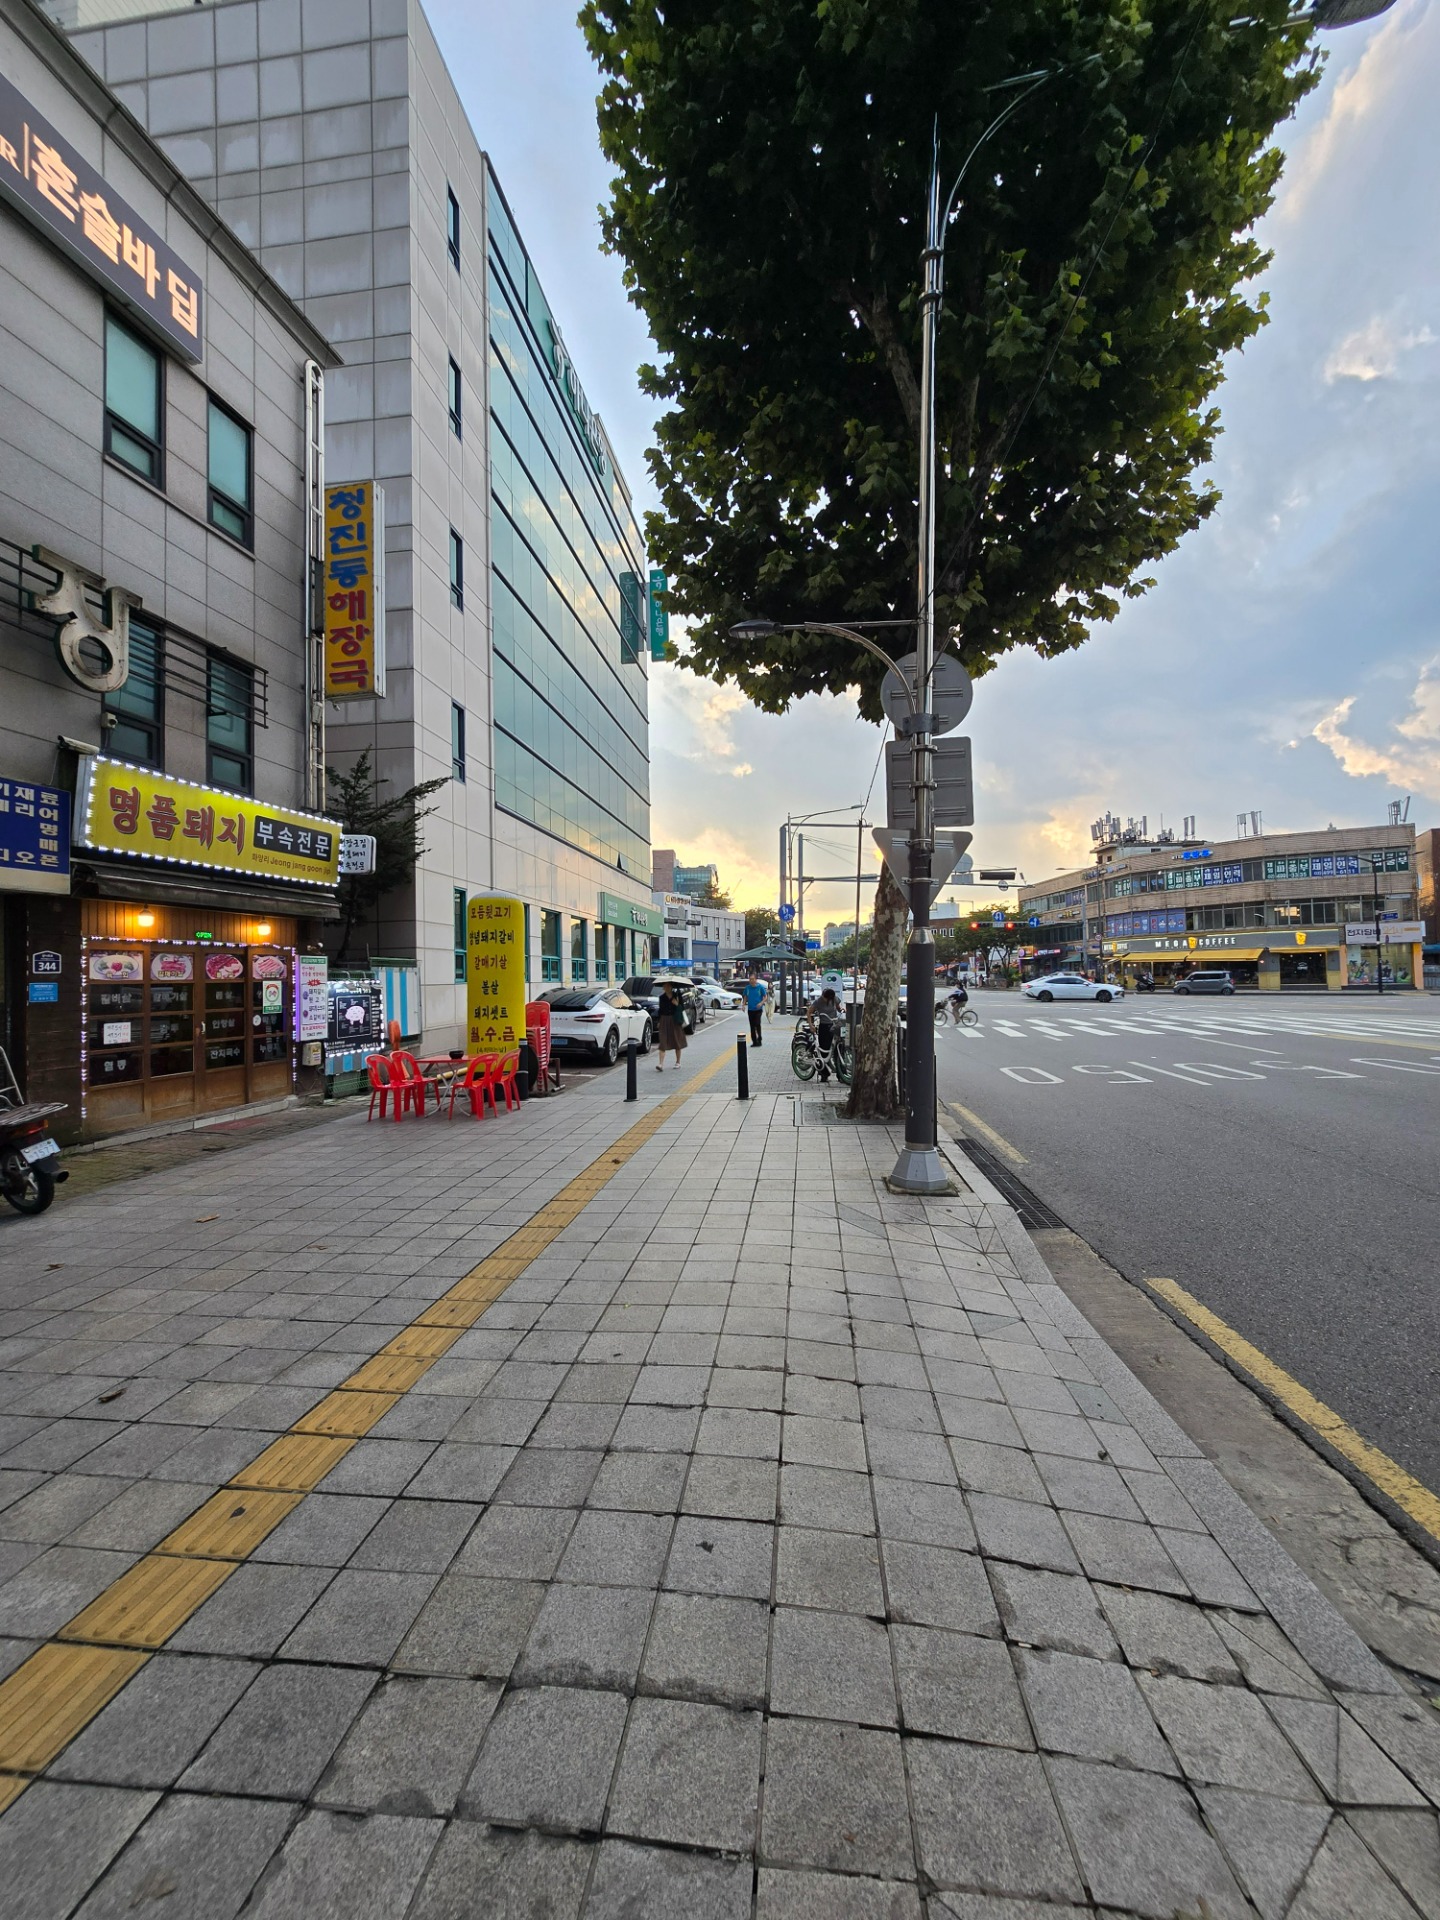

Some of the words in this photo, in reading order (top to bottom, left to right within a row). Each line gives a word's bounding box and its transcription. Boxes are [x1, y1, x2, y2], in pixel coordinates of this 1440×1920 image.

[32, 132, 161, 299] 혼술바
[168, 267, 198, 339] 딥
[108, 786, 246, 855] 명품돼지
[256, 821, 330, 857] 부속전문
[270, 857, 291, 869] Jeong
[292, 860, 306, 871] jang
[307, 863, 323, 873] goon
[470, 904, 512, 920] 모듬뒷고기
[469, 928, 515, 946] 양념돼지갈비
[1155, 940, 1188, 948] MEGA
[1199, 937, 1236, 946] COFFEE
[38, 962, 57, 971] 344
[474, 954, 507, 971] 갈매기살
